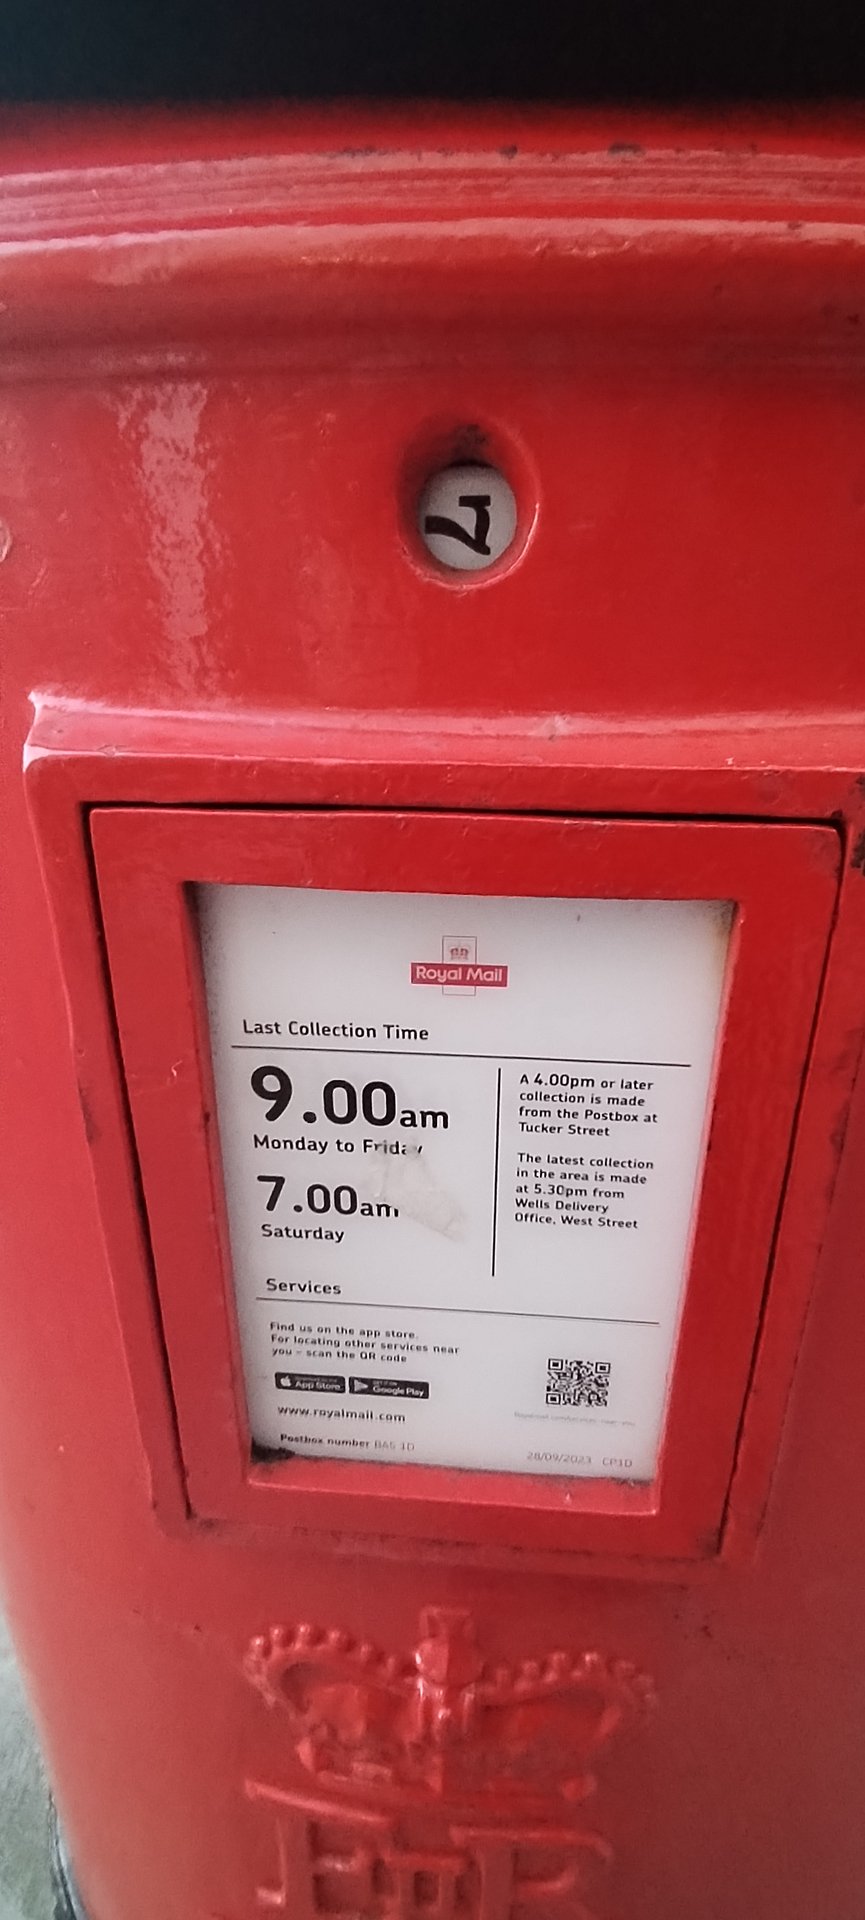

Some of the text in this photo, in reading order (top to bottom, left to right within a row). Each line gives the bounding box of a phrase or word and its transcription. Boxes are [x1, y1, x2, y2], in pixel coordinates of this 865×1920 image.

[415, 965, 503, 983] Royal Mail
[243, 1019, 429, 1041] Last Collection Time
[520, 1073, 654, 1090] A 4.00pm or later
[250, 1065, 449, 1130] 9.00am
[520, 1092, 645, 1106] collection is made
[519, 1107, 657, 1122] from the Postbox at
[519, 1122, 610, 1136] Tucker Street
[254, 1135, 328, 1154] Monday
[336, 1139, 354, 1152] to
[517, 1153, 654, 1169] The latest collection
[517, 1168, 647, 1184] in the area is made
[257, 1175, 399, 1218] 7.00am
[516, 1184, 624, 1198] at 5.30pm from
[515, 1199, 609, 1213] Wells Delivery
[515, 1213, 638, 1228] Office, West Street
[261, 1224, 345, 1243] Saturday
[266, 1278, 341, 1294] Services
[270, 1322, 418, 1339] Find us on the app store.
[271, 1335, 460, 1354] For locating other services near
[272, 1348, 292, 1357] you
[306, 1350, 332, 1358] scan
[337, 1350, 355, 1359] the
[360, 1352, 376, 1360] QR
[381, 1354, 407, 1362] code
[295, 1381, 340, 1390] App Store
[372, 1385, 424, 1397] Google Play
[278, 1405, 406, 1423] www.royalmail.com
[280, 1434, 323, 1444] Postbox
[327, 1438, 370, 1447] number
